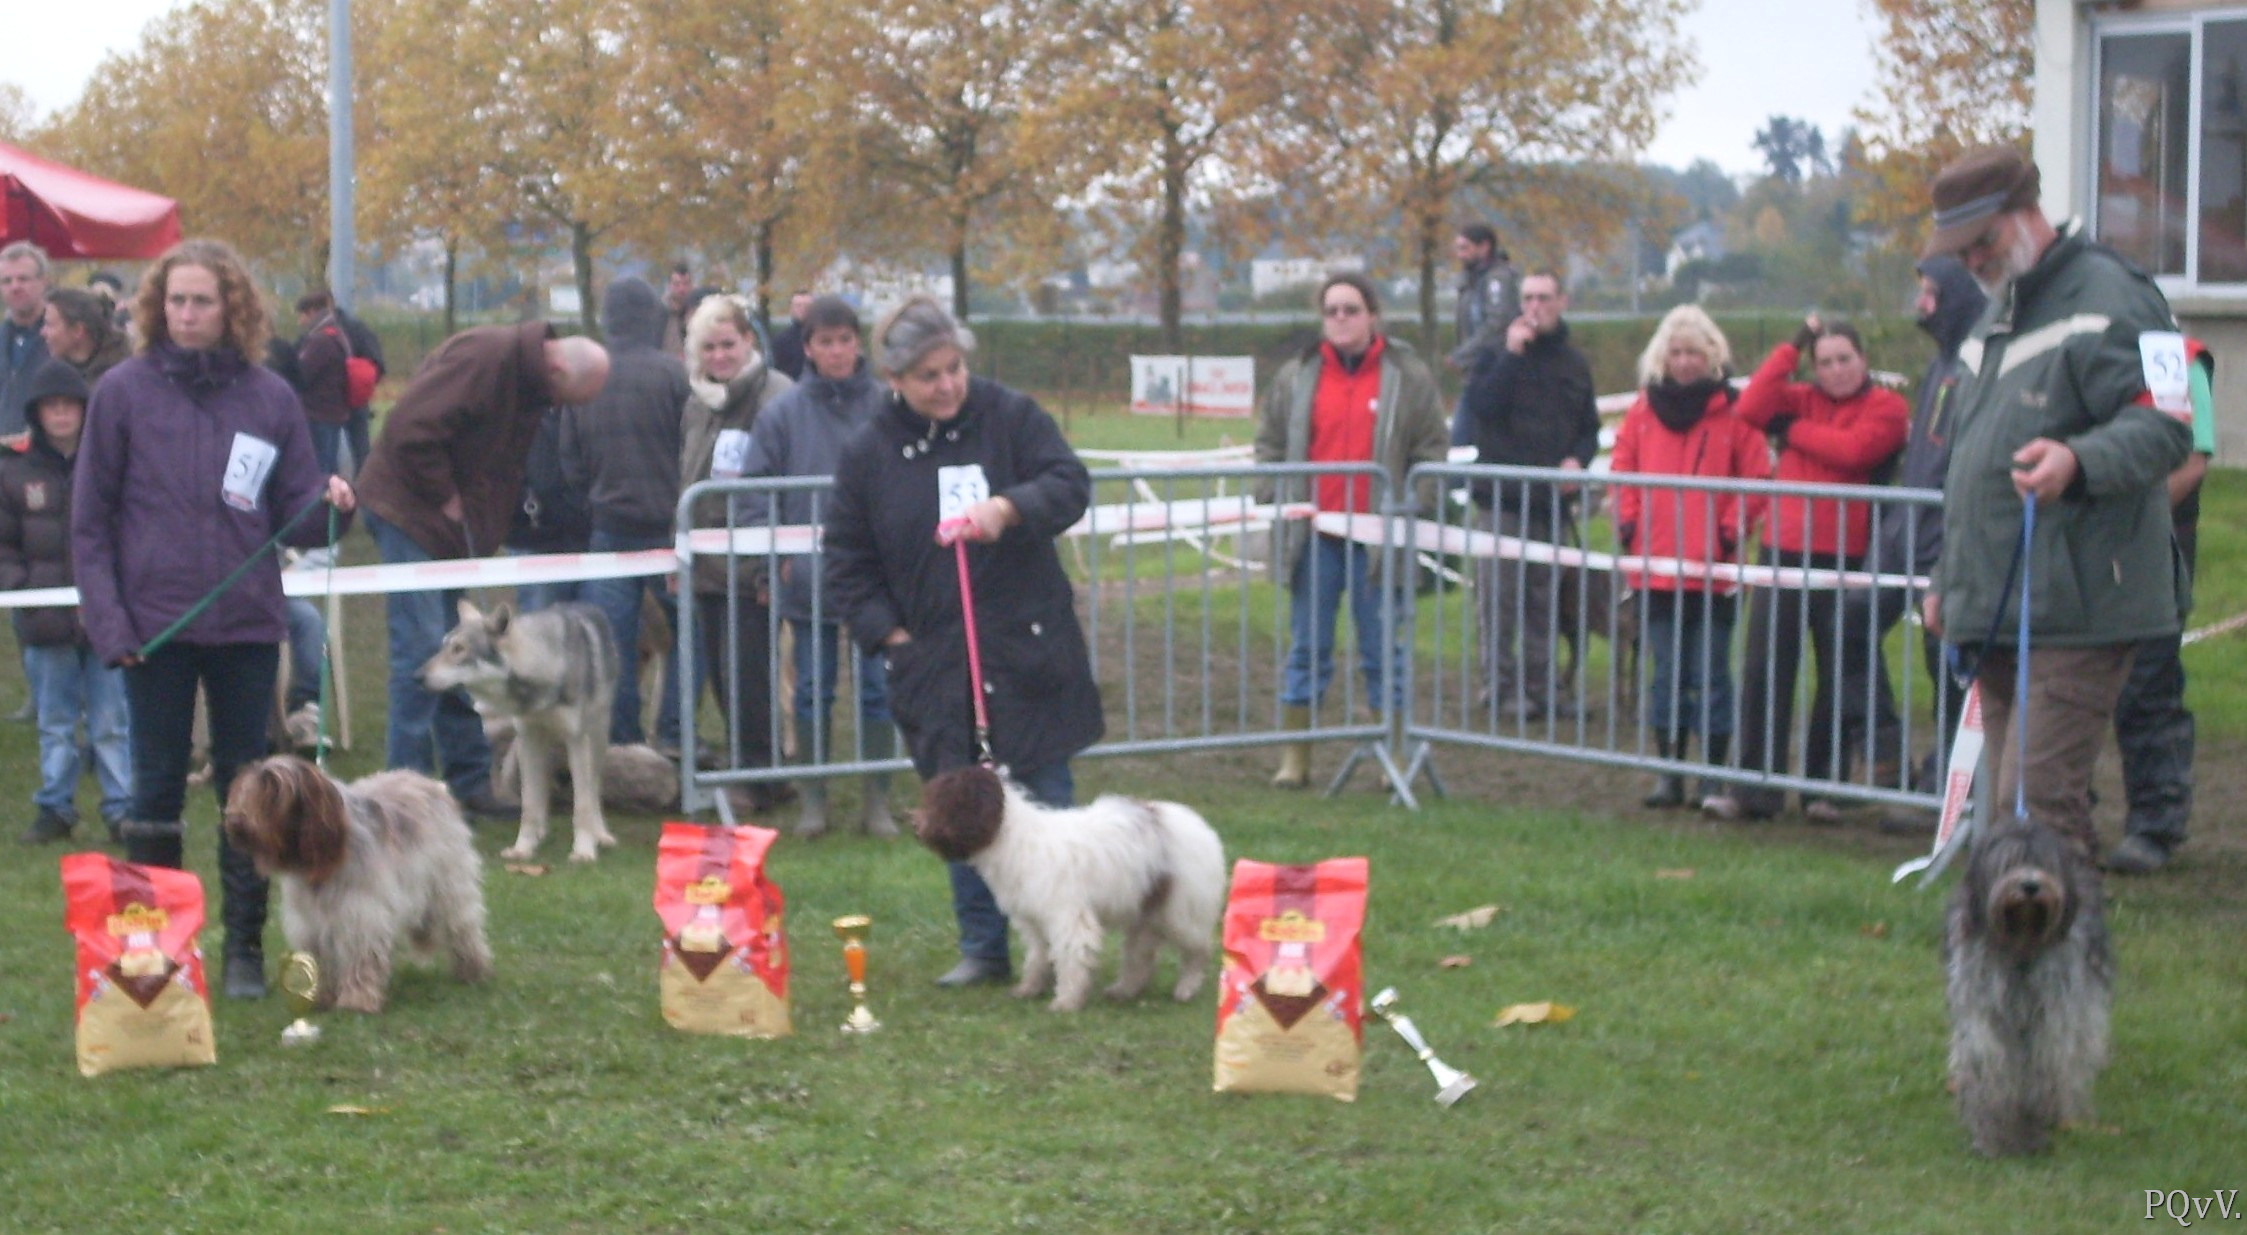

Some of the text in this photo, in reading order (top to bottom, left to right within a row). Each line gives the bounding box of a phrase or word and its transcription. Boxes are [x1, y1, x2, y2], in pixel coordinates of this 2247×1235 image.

[2153, 351, 2184, 382] 52
[233, 453, 264, 487] 51
[949, 483, 979, 510] 53
